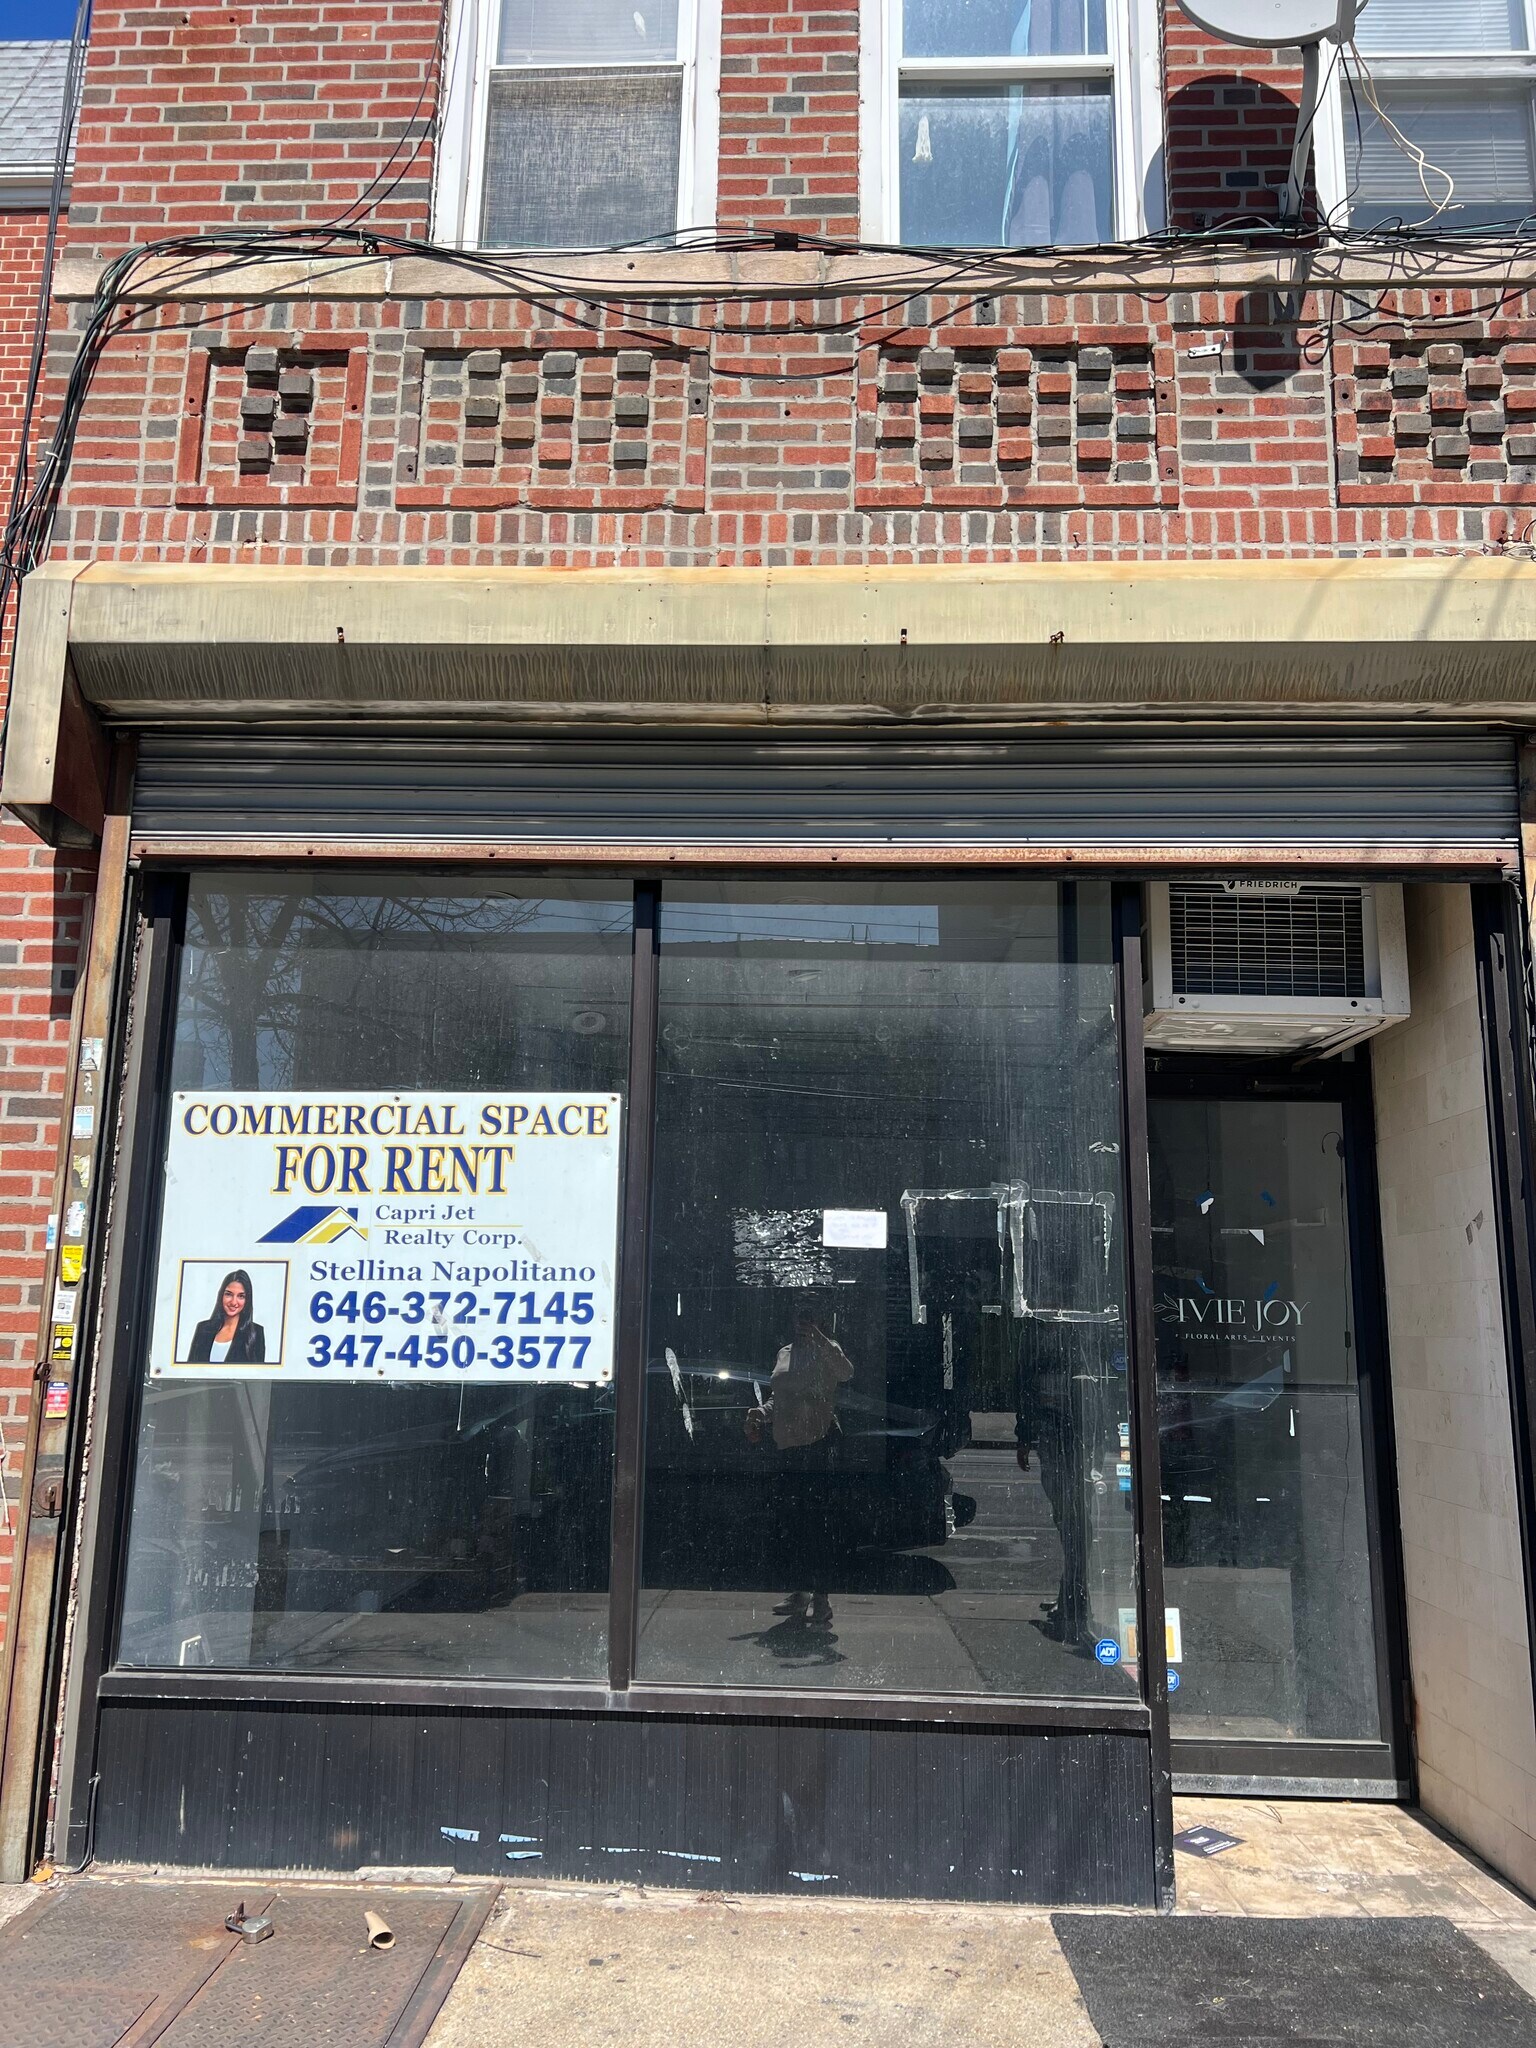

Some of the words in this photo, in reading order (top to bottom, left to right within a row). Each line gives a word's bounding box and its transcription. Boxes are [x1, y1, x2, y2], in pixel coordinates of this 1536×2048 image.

[182, 1103, 466, 1136] COMMERCIAL
[478, 1103, 609, 1136] SPACE
[271, 1143, 373, 1195] FOR
[379, 1143, 516, 1196] RENT
[374, 1204, 436, 1222] Capri
[441, 1205, 476, 1221] Jet
[384, 1228, 455, 1248] Realty
[463, 1229, 523, 1249] Corp.
[309, 1259, 422, 1282] Stellina
[431, 1260, 596, 1288] Napolitano
[309, 1290, 595, 1325] 646-372-7145
[1177, 1298, 1246, 1324] IVIE
[1252, 1300, 1311, 1332] JOY
[307, 1334, 592, 1370] 347-450-3577
[1100, 1647, 1116, 1657] ADT
